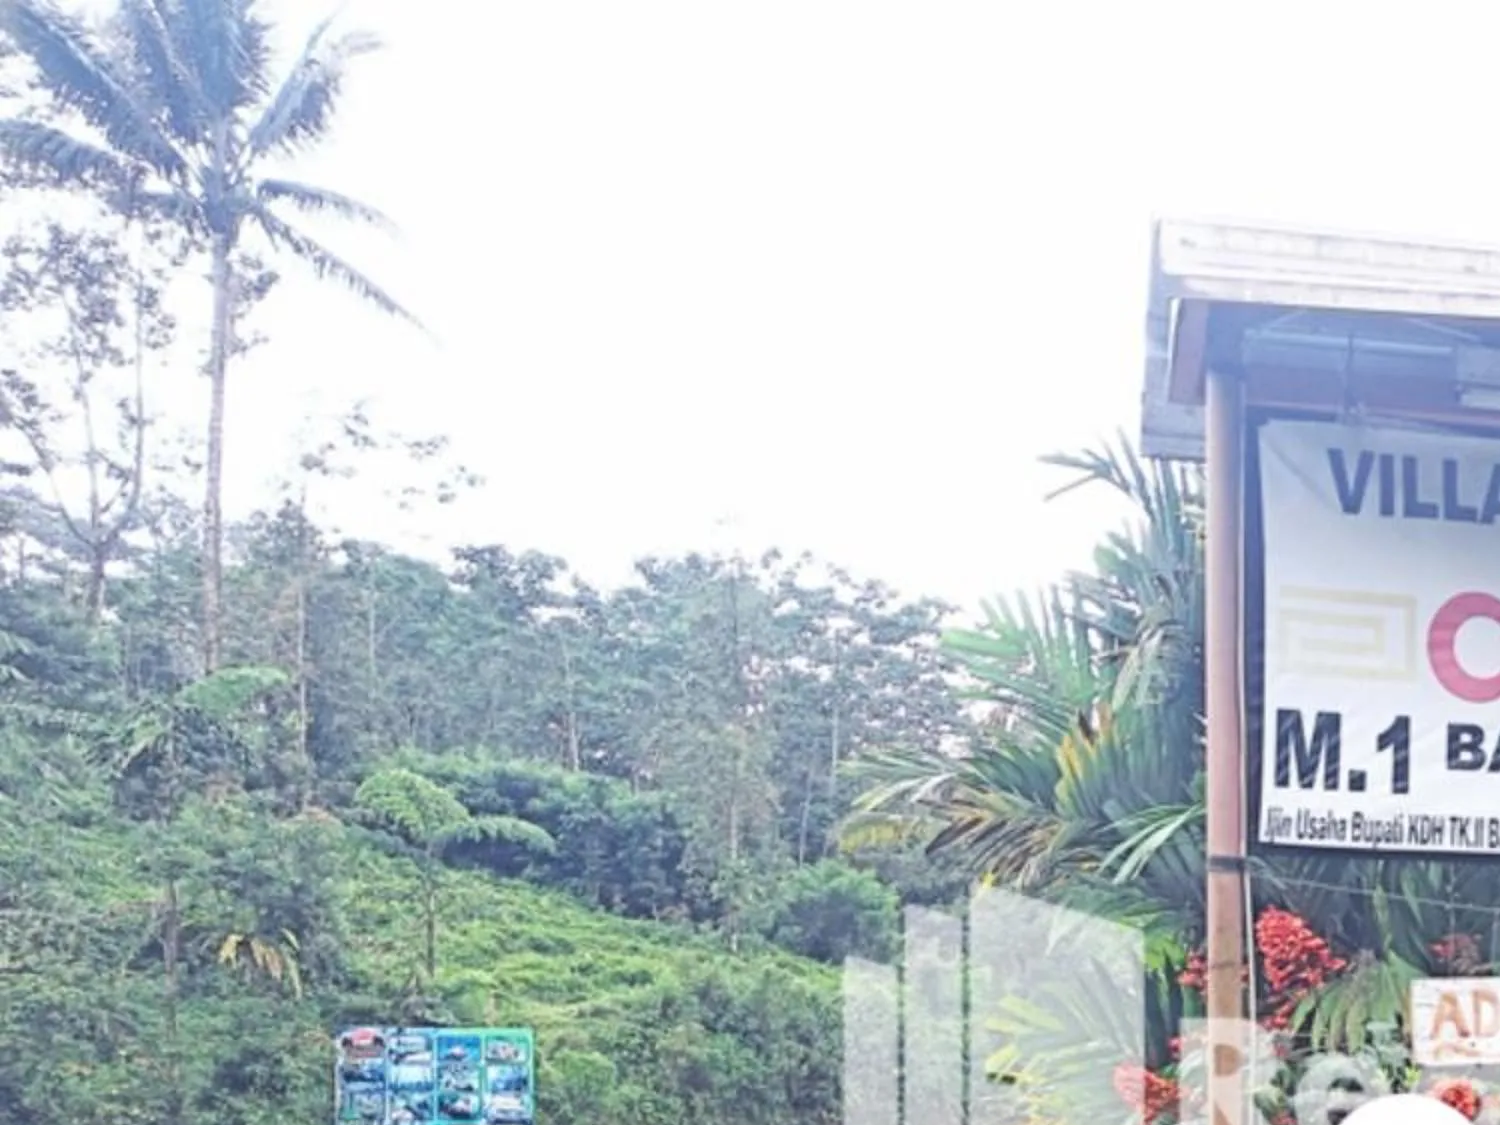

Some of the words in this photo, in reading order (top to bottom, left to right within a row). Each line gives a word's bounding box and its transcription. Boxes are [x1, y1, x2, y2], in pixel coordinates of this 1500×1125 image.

[1274, 708, 1411, 795] M.1
[1297, 807, 1346, 841] Usaha
[1352, 811, 1404, 849] Bupati
[1408, 815, 1445, 845] KDH
